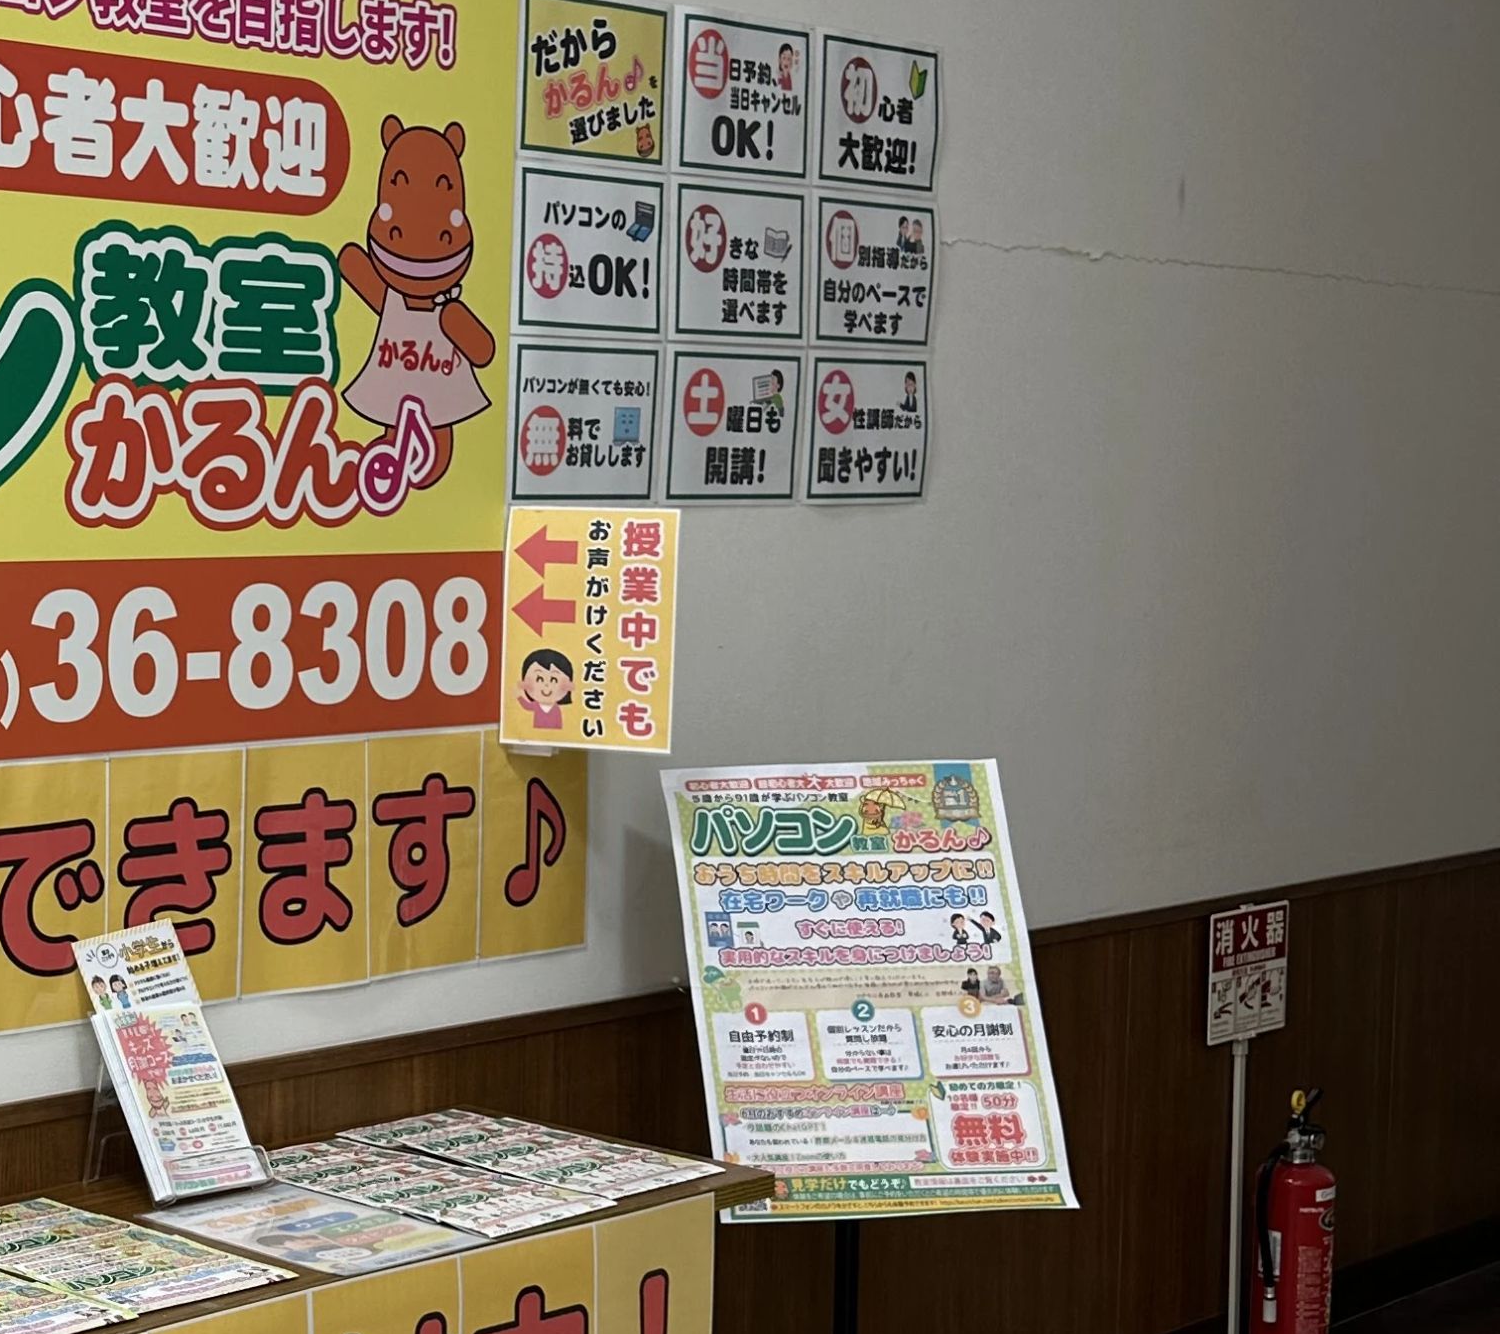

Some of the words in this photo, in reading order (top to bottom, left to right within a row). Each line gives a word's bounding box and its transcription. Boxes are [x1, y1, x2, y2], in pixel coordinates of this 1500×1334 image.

[530, 18, 618, 77] だから
[729, 88, 801, 115] 当日キャンセル
[842, 59, 914, 125] 初心者
[568, 96, 655, 145] 選びました
[838, 137, 918, 175] 大歓迎!
[543, 200, 626, 229] パソコンの
[687, 208, 760, 269] 好きな
[722, 270, 788, 296] 時間帯を
[823, 279, 927, 308] 自分のペースで
[76, 219, 338, 395] 教室
[722, 300, 788, 325] 選べます
[843, 310, 903, 335] 学べます
[687, 370, 782, 434] 土曜日も
[820, 373, 923, 430] 女性講師だから
[523, 410, 601, 470] 無料で
[565, 443, 647, 469] お貸しします
[704, 447, 766, 485] 開講!
[817, 449, 918, 484] 聞きやすい!
[583, 520, 612, 737] お声がけください
[619, 520, 662, 738] 授業中でも
[690, 806, 857, 856] パソコン
[1216, 910, 1285, 956] 消火器
[952, 1113, 1026, 1146] 無料
